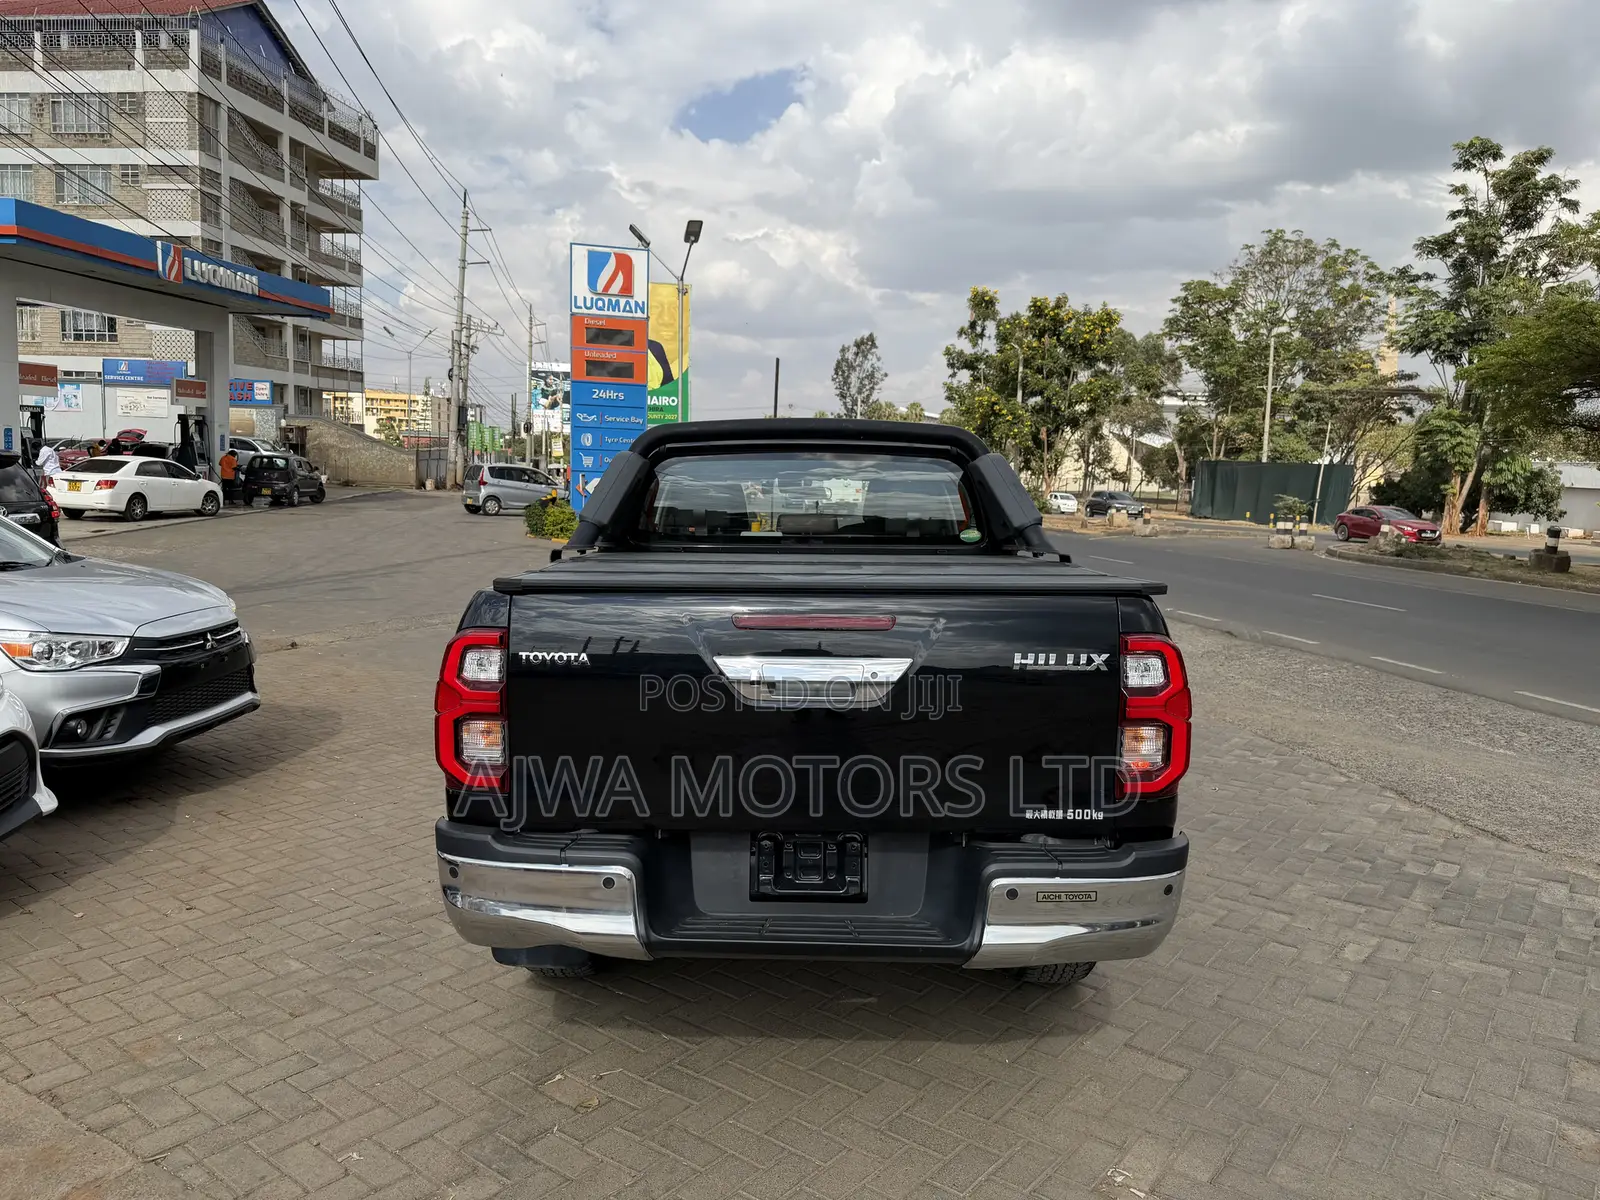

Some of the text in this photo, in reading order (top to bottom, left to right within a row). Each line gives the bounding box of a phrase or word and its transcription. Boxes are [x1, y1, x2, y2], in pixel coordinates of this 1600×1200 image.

[183, 256, 259, 296] LUQMAN
[573, 295, 646, 315] LUQMAN
[584, 318, 606, 326] Diesel
[584, 351, 617, 359] Unleaded
[592, 388, 625, 400] 24Hrs
[630, 416, 644, 424] Bay
[604, 436, 619, 444] Tyre
[518, 651, 591, 666] TOYOTA
[1013, 652, 1111, 671] HILUX
[1066, 808, 1104, 820] 500kg
[1041, 893, 1093, 901] AICHI TOYOTA
